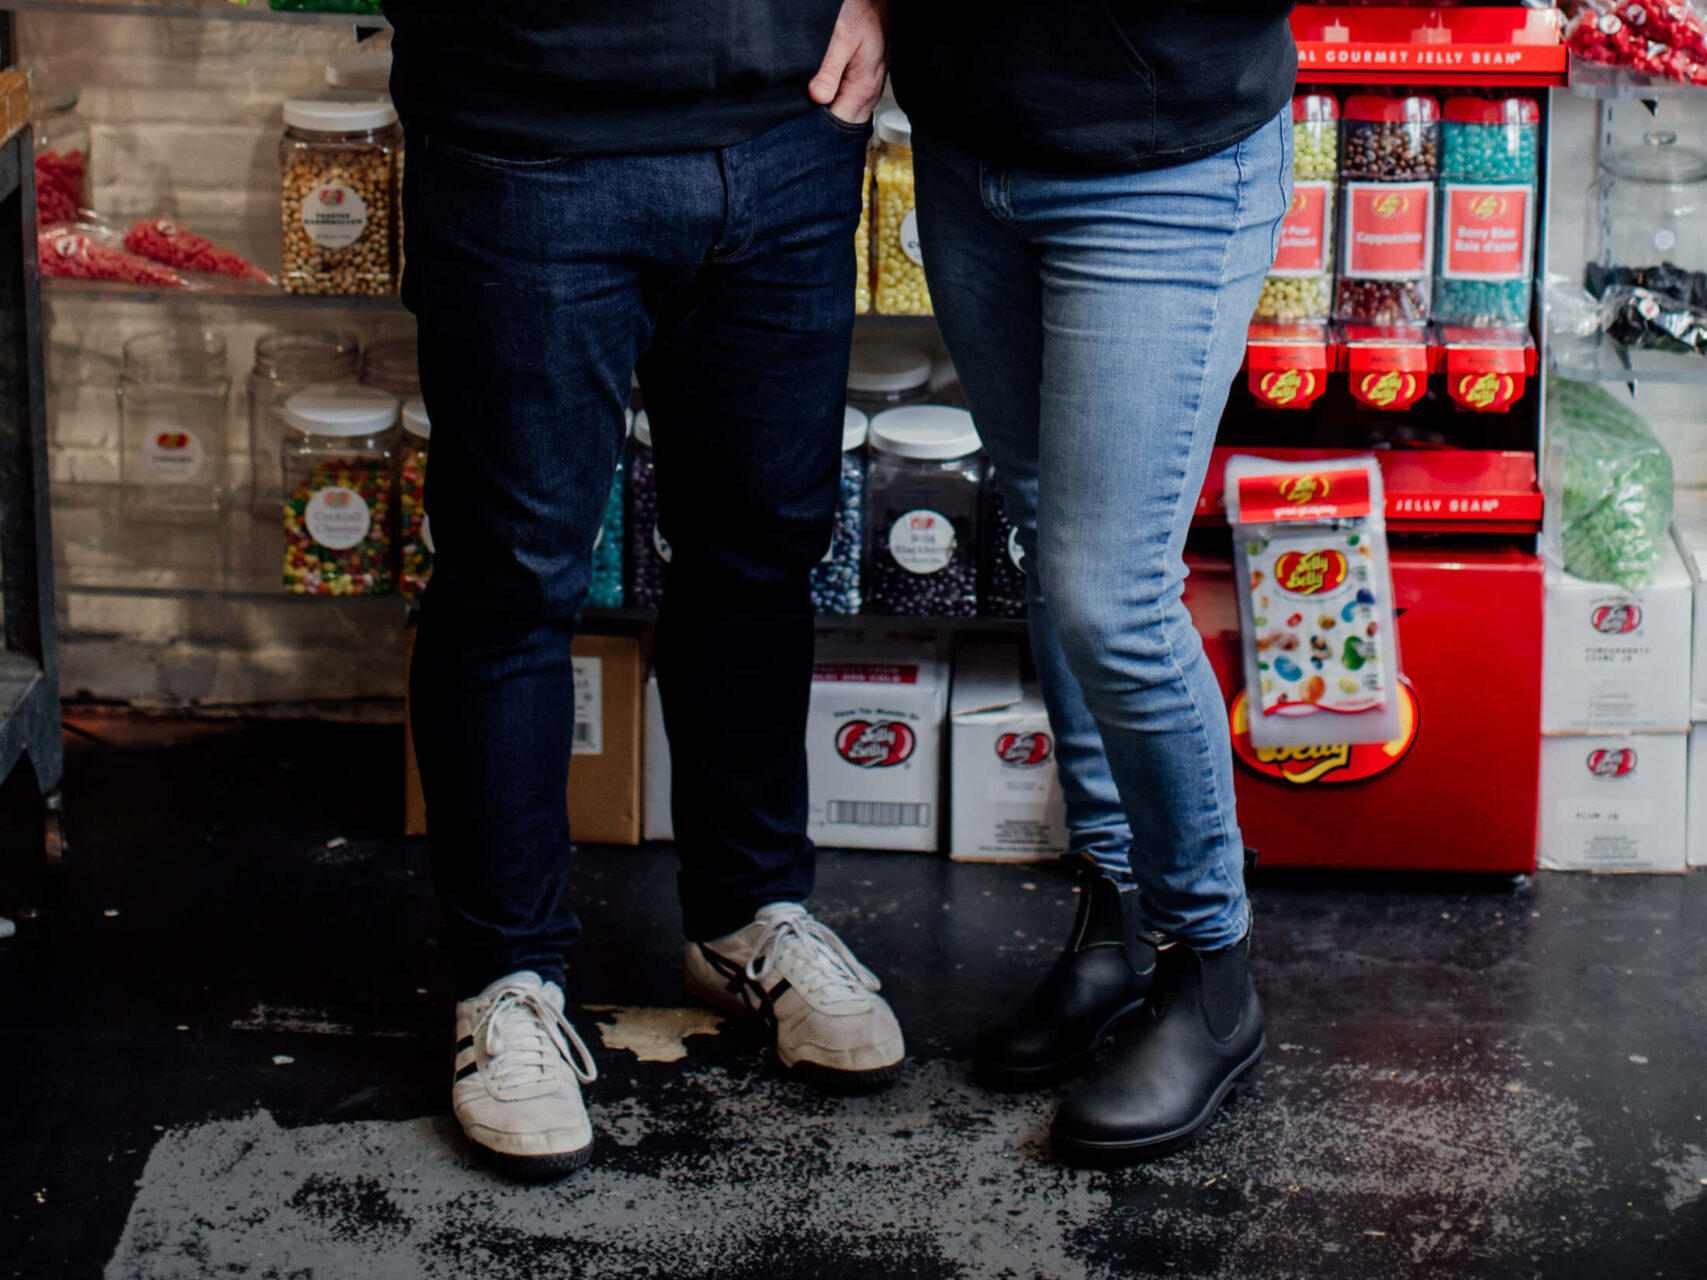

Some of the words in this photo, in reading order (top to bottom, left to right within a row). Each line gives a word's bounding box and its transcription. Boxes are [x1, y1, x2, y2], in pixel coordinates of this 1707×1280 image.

[1297, 50, 1317, 62] AL
[1325, 50, 1409, 64] GOURMET
[1416, 51, 1464, 64] JELLY
[1457, 225, 1489, 241] Berry
[1490, 226, 1517, 239] Blue
[1395, 499, 1441, 512] JELLY
[1296, 549, 1329, 573] Jelly
[1286, 569, 1325, 595] Belly
[859, 720, 897, 746] Jelly
[847, 741, 891, 768] Belly
